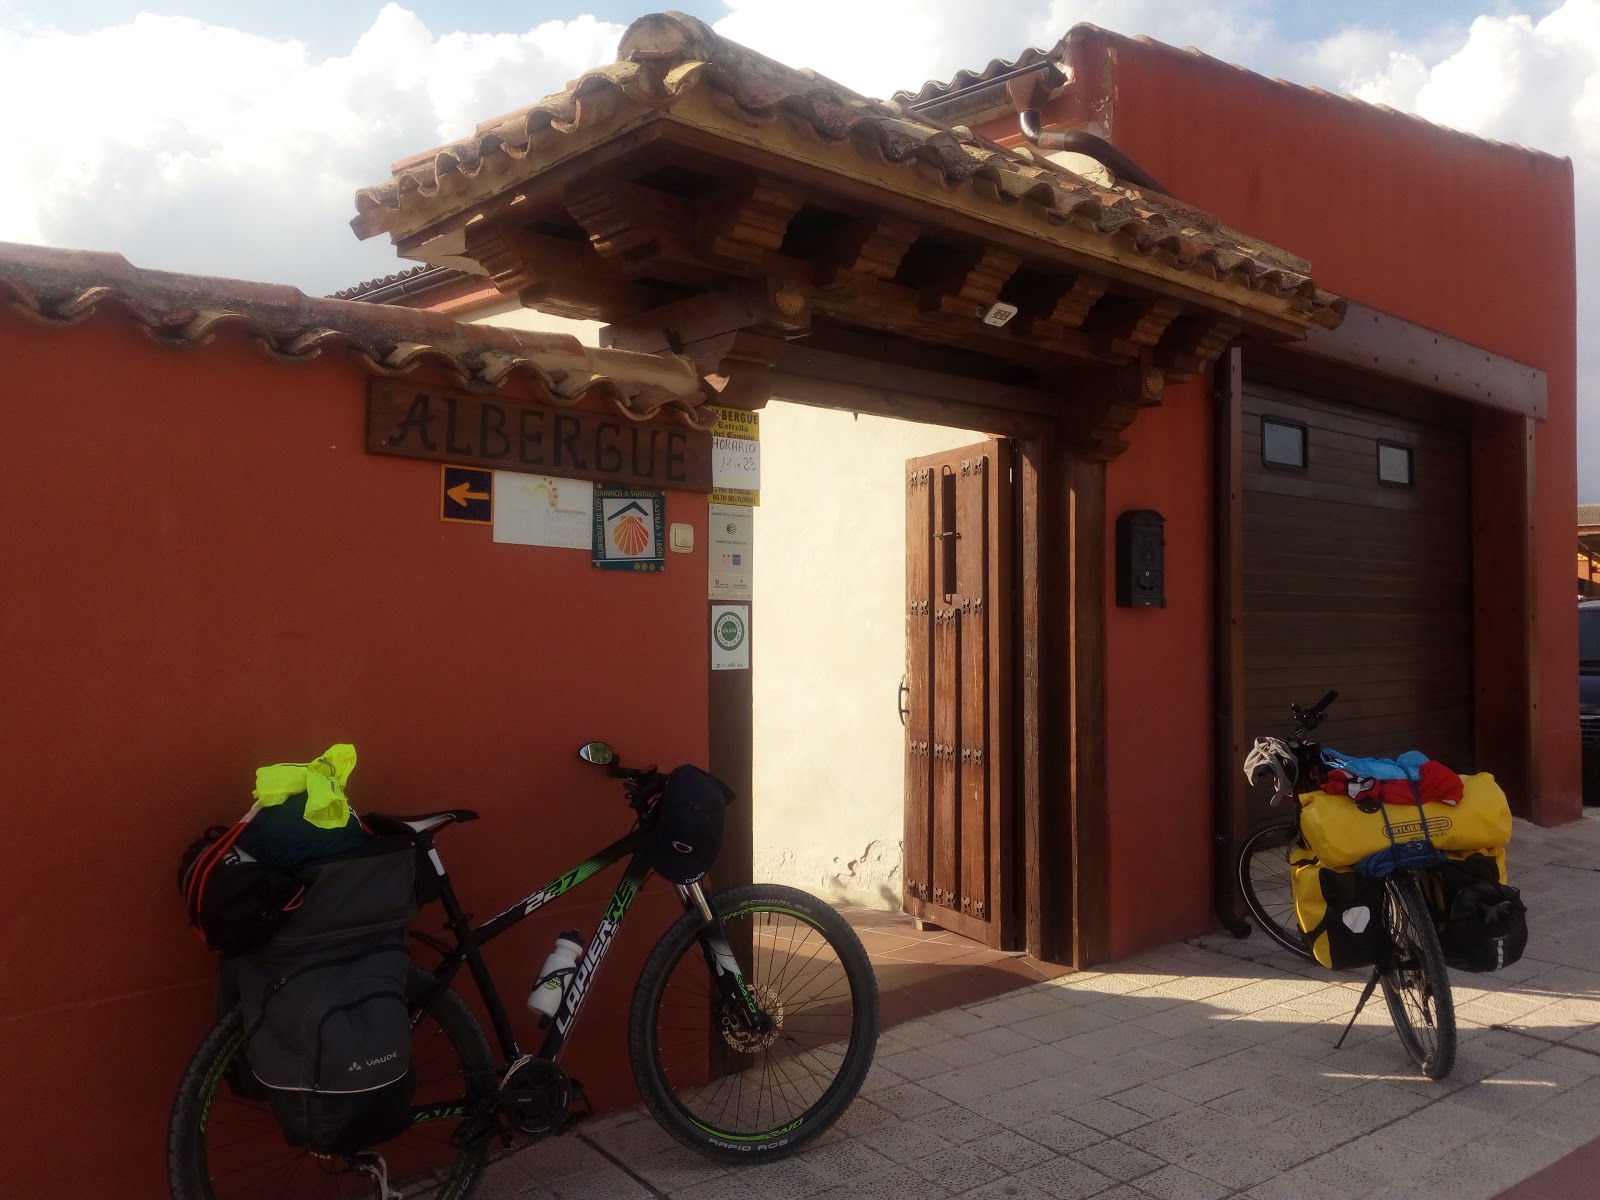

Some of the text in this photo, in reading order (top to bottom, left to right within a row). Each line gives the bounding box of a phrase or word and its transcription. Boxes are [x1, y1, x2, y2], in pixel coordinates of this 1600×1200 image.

[712, 408, 759, 425] BERGUE
[718, 421, 749, 432] Estrella
[388, 392, 688, 483] ALBERGUE
[712, 438, 756, 454] HORARIO
[595, 489, 623, 498] CAMINOS
[630, 490, 659, 498] SANTIAGO
[596, 512, 603, 523] DE
[524, 868, 580, 916] 227
[739, 898, 813, 915] SCHWALBE
[555, 879, 636, 1036] LAPIERRE
[365, 1051, 399, 1068] VAUDE
[708, 1138, 789, 1152] RAPID ROB
